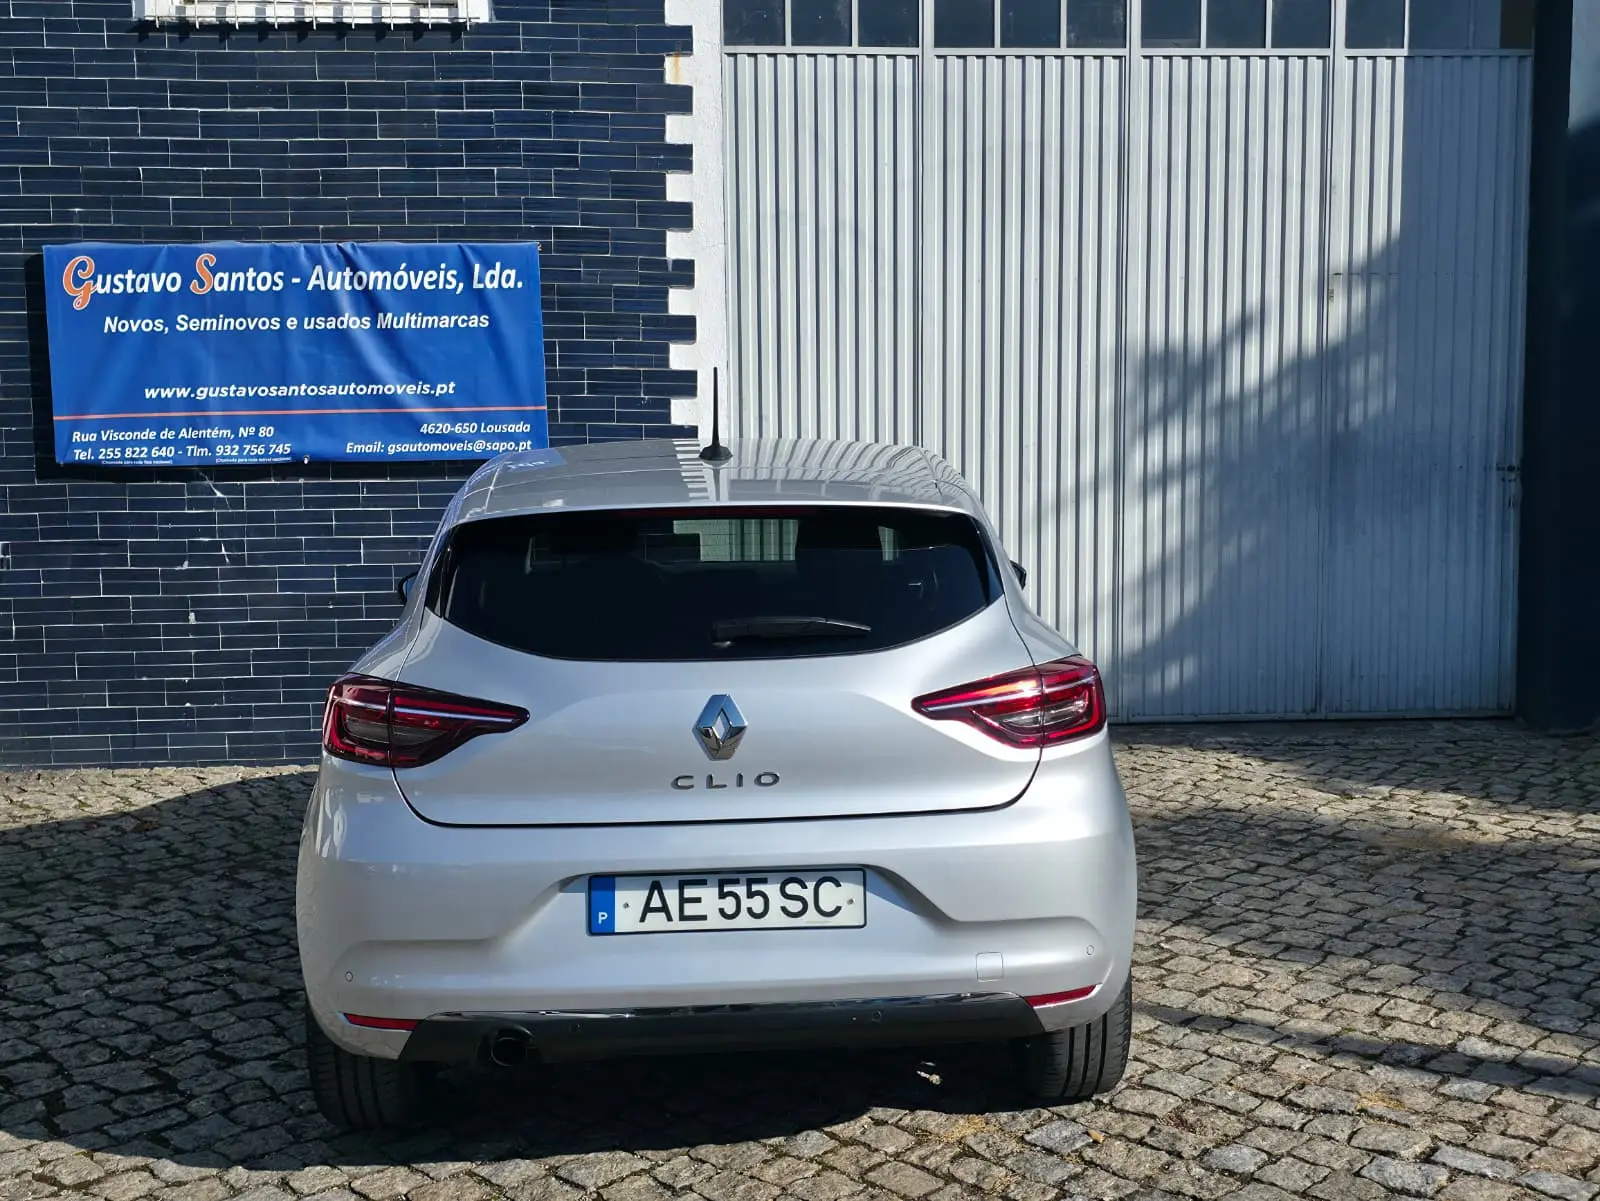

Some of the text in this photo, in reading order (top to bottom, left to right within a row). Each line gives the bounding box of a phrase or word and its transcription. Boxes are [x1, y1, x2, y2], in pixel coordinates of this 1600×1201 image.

[62, 255, 182, 311] Gustavo
[190, 253, 285, 295] Santos
[306, 262, 465, 295] Automóveis,
[472, 261, 524, 289] Lda.
[103, 312, 490, 334] Novos, Seminovos e usados Multimarcas
[144, 381, 456, 400] www.gustavosantosautomoveis.pt
[72, 430, 97, 443] Rua
[101, 428, 156, 442] Visconde
[160, 427, 176, 440] de
[178, 426, 235, 441] Alentém,
[258, 426, 275, 438] 80
[419, 421, 531, 435] 4620-650 Lousada
[74, 449, 95, 460] Tel.
[98, 447, 122, 460] 255
[124, 446, 149, 458] 822
[151, 446, 175, 457] 640
[186, 445, 212, 457] Tlm.
[215, 444, 240, 456] 932
[242, 443, 266, 455] 756
[268, 443, 292, 455] 745
[346, 439, 532, 455] Email: gsautomoveis@sapo.pt
[671, 771, 780, 790] CLIO
[598, 911, 608, 924] P
